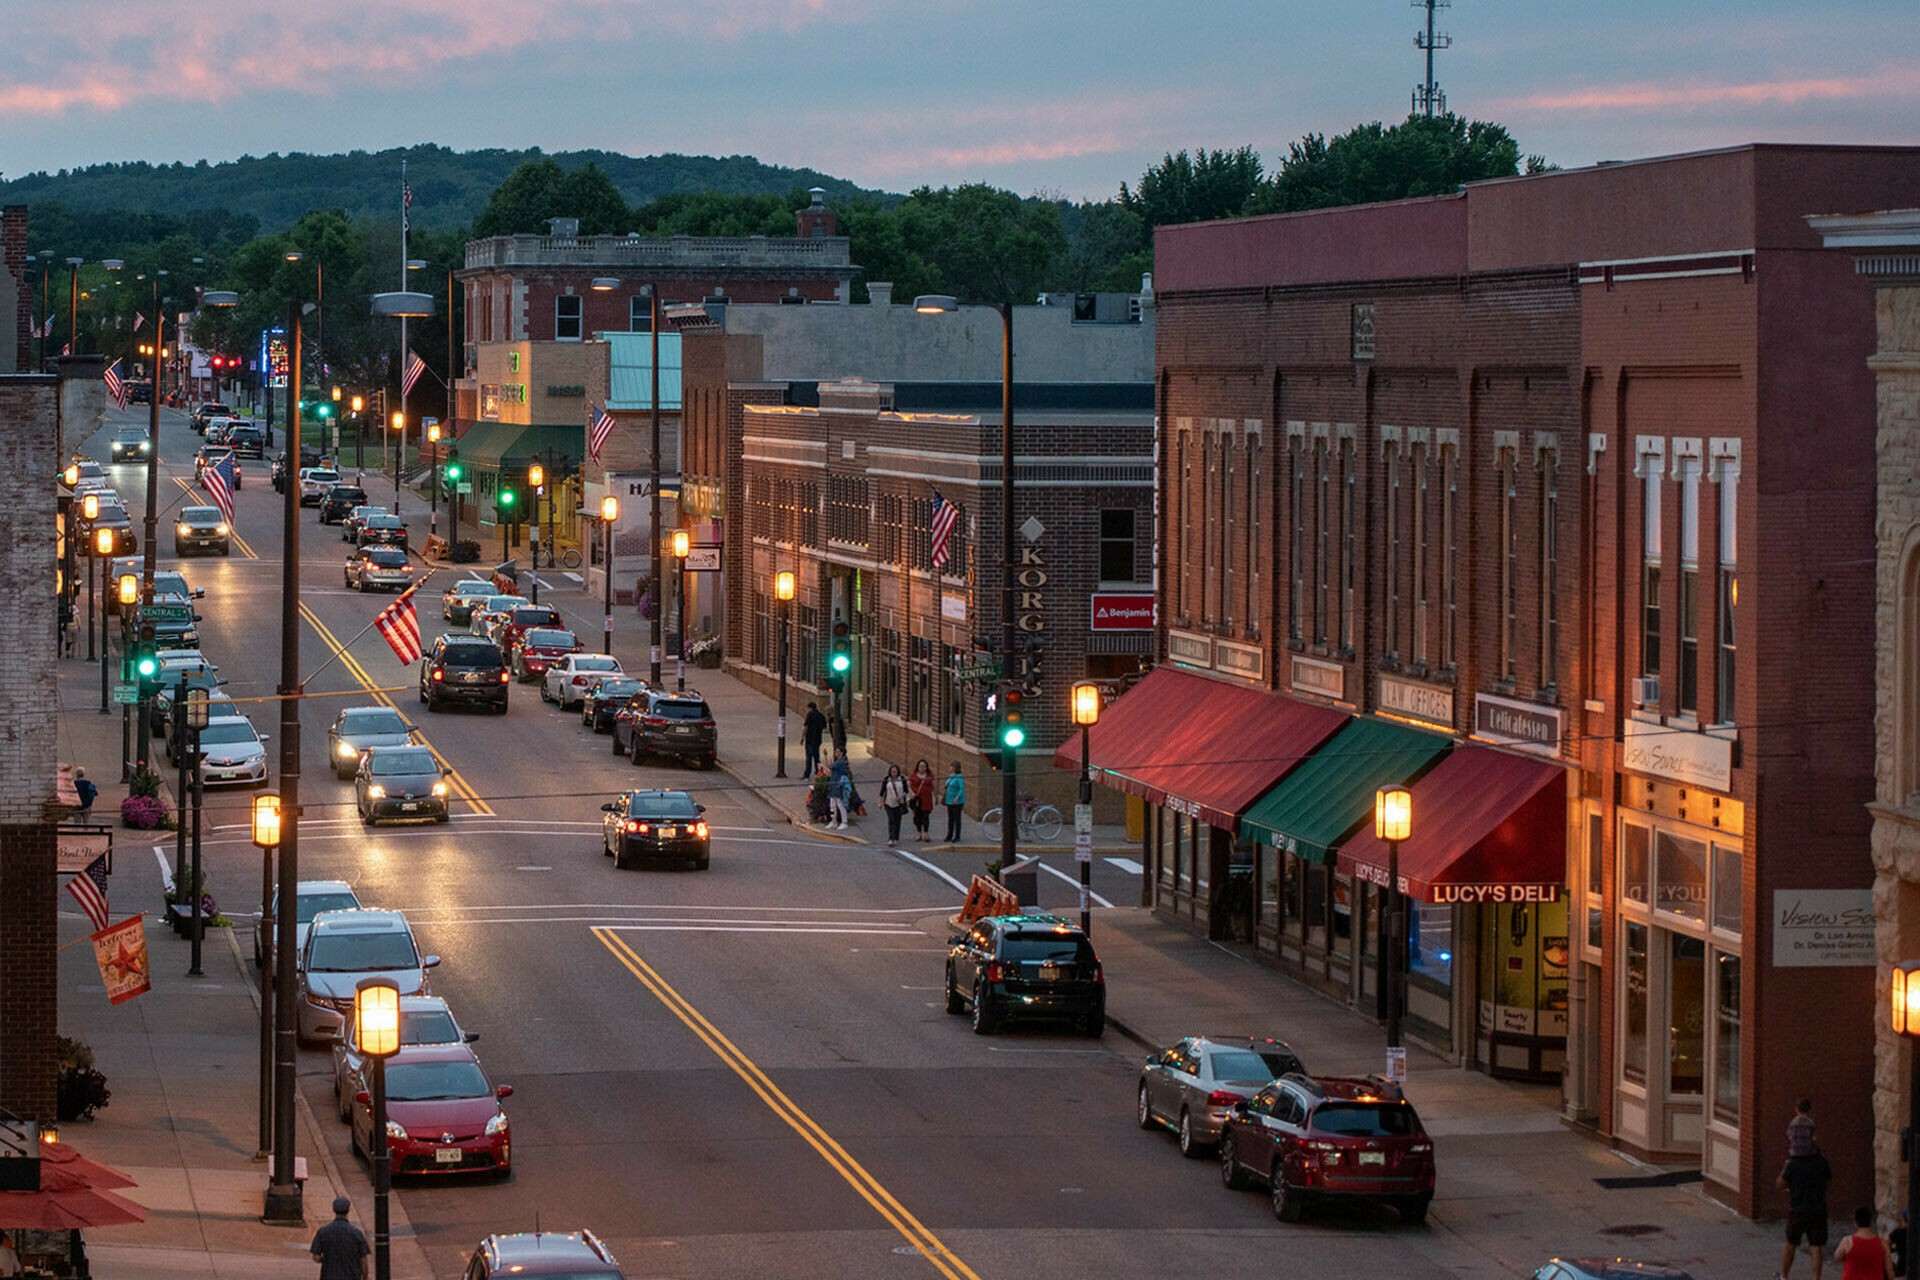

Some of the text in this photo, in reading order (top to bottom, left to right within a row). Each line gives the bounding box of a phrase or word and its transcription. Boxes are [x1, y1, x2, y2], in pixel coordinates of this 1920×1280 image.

[143, 607, 177, 617] CENTRAL
[1110, 608, 1151, 619] Benjamin
[960, 667, 997, 679] CENTRAL
[1409, 687, 1449, 719] OFFICES
[1489, 708, 1549, 741] Delicatessen
[1434, 886, 1555, 903] LUCY'S DELI
